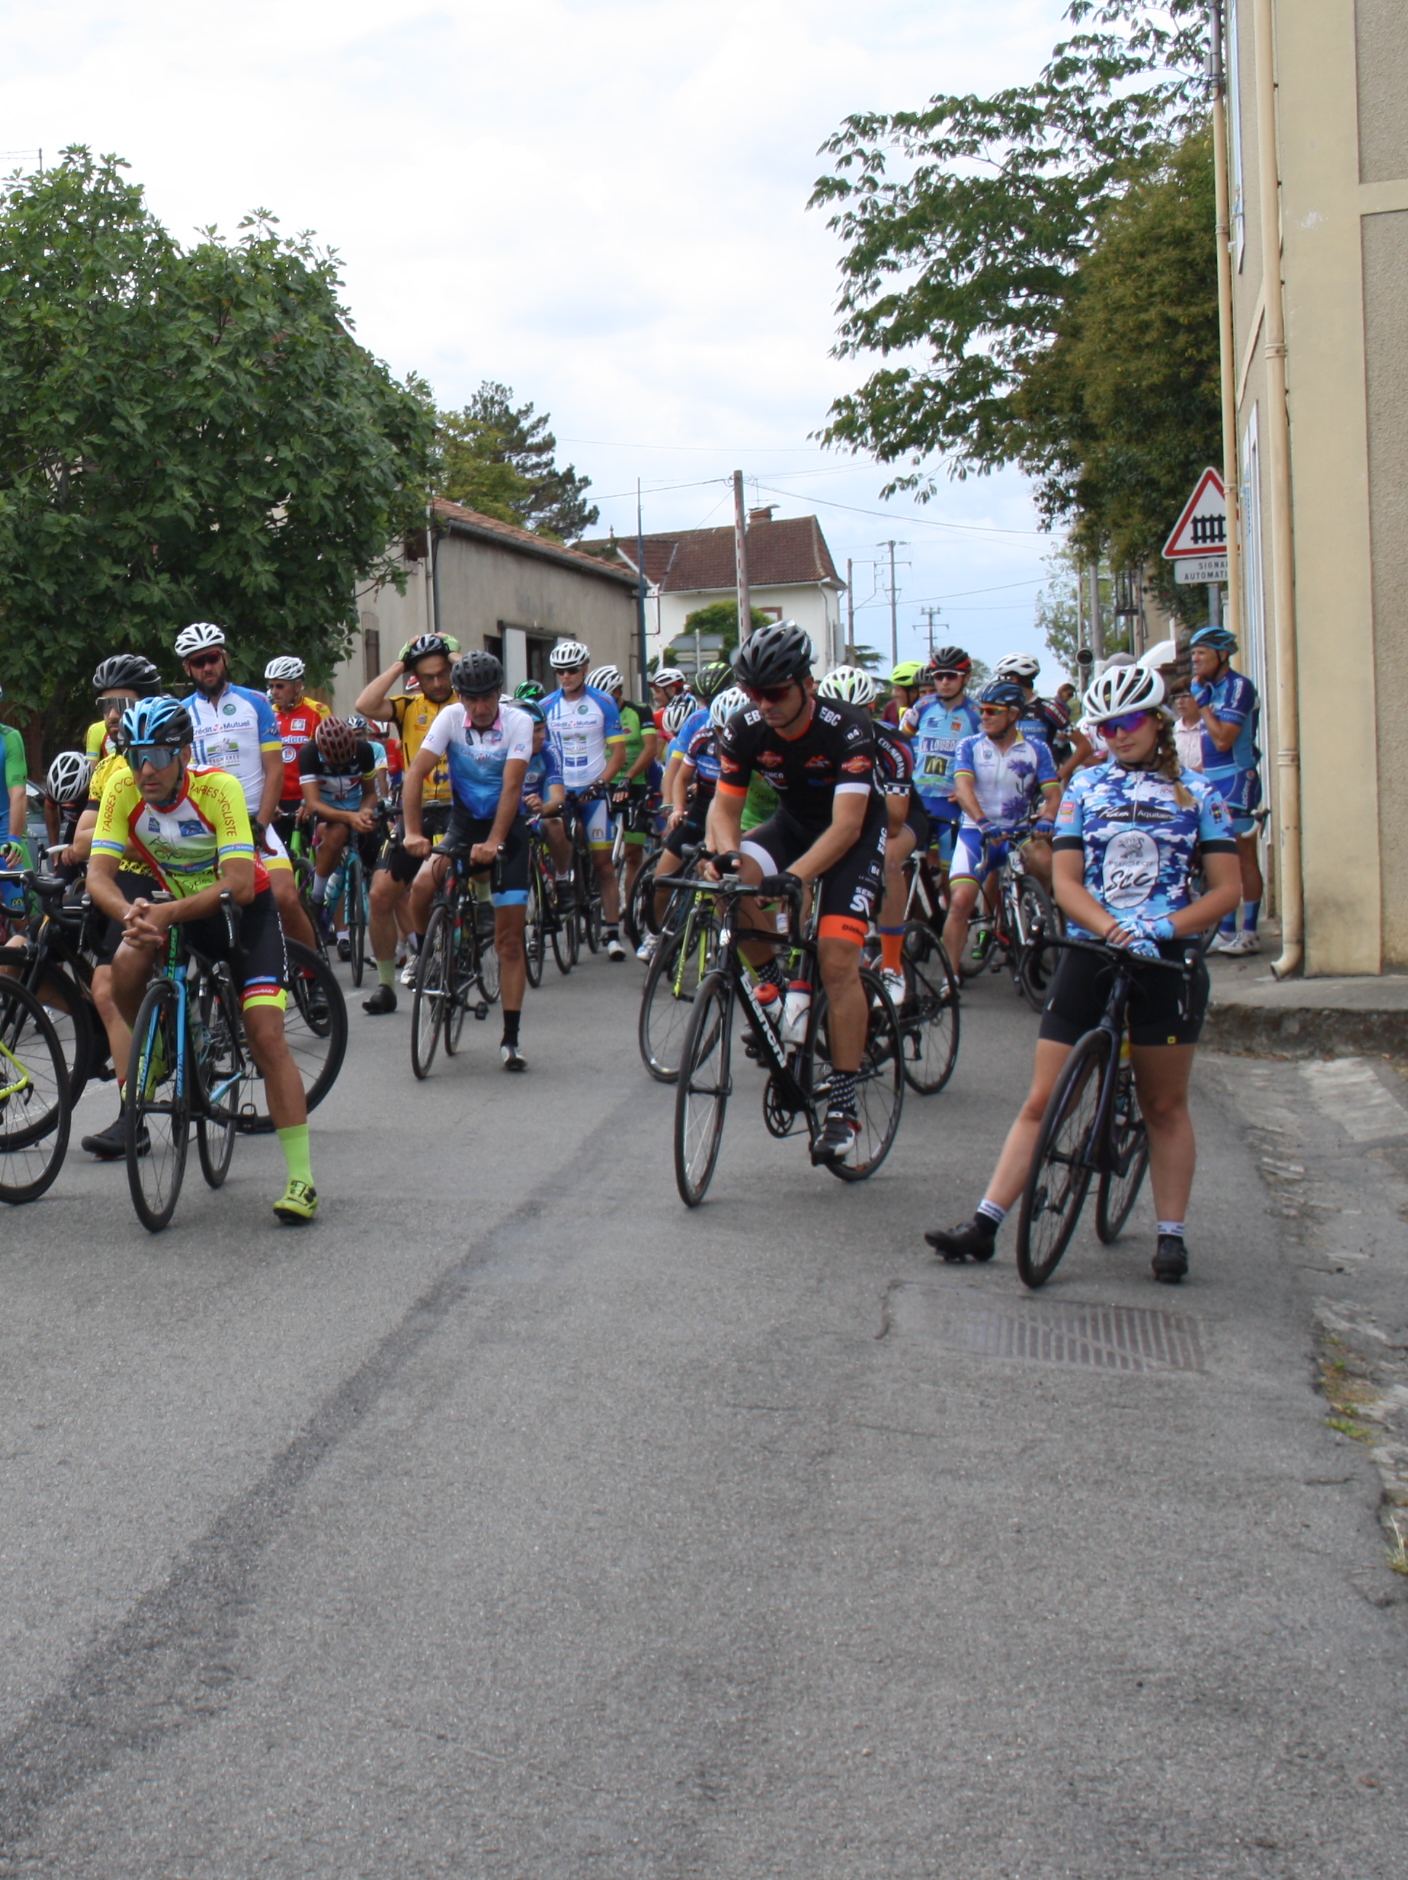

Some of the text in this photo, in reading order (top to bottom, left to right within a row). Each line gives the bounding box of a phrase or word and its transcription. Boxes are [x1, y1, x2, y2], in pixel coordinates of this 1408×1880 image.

[223, 720, 251, 729] Mutuel
[744, 710, 763, 726] EB
[819, 706, 841, 727] EBC
[878, 737, 905, 779] COUSERANS
[102, 794, 117, 833] TARBES
[218, 793, 238, 837] CYCLISTE
